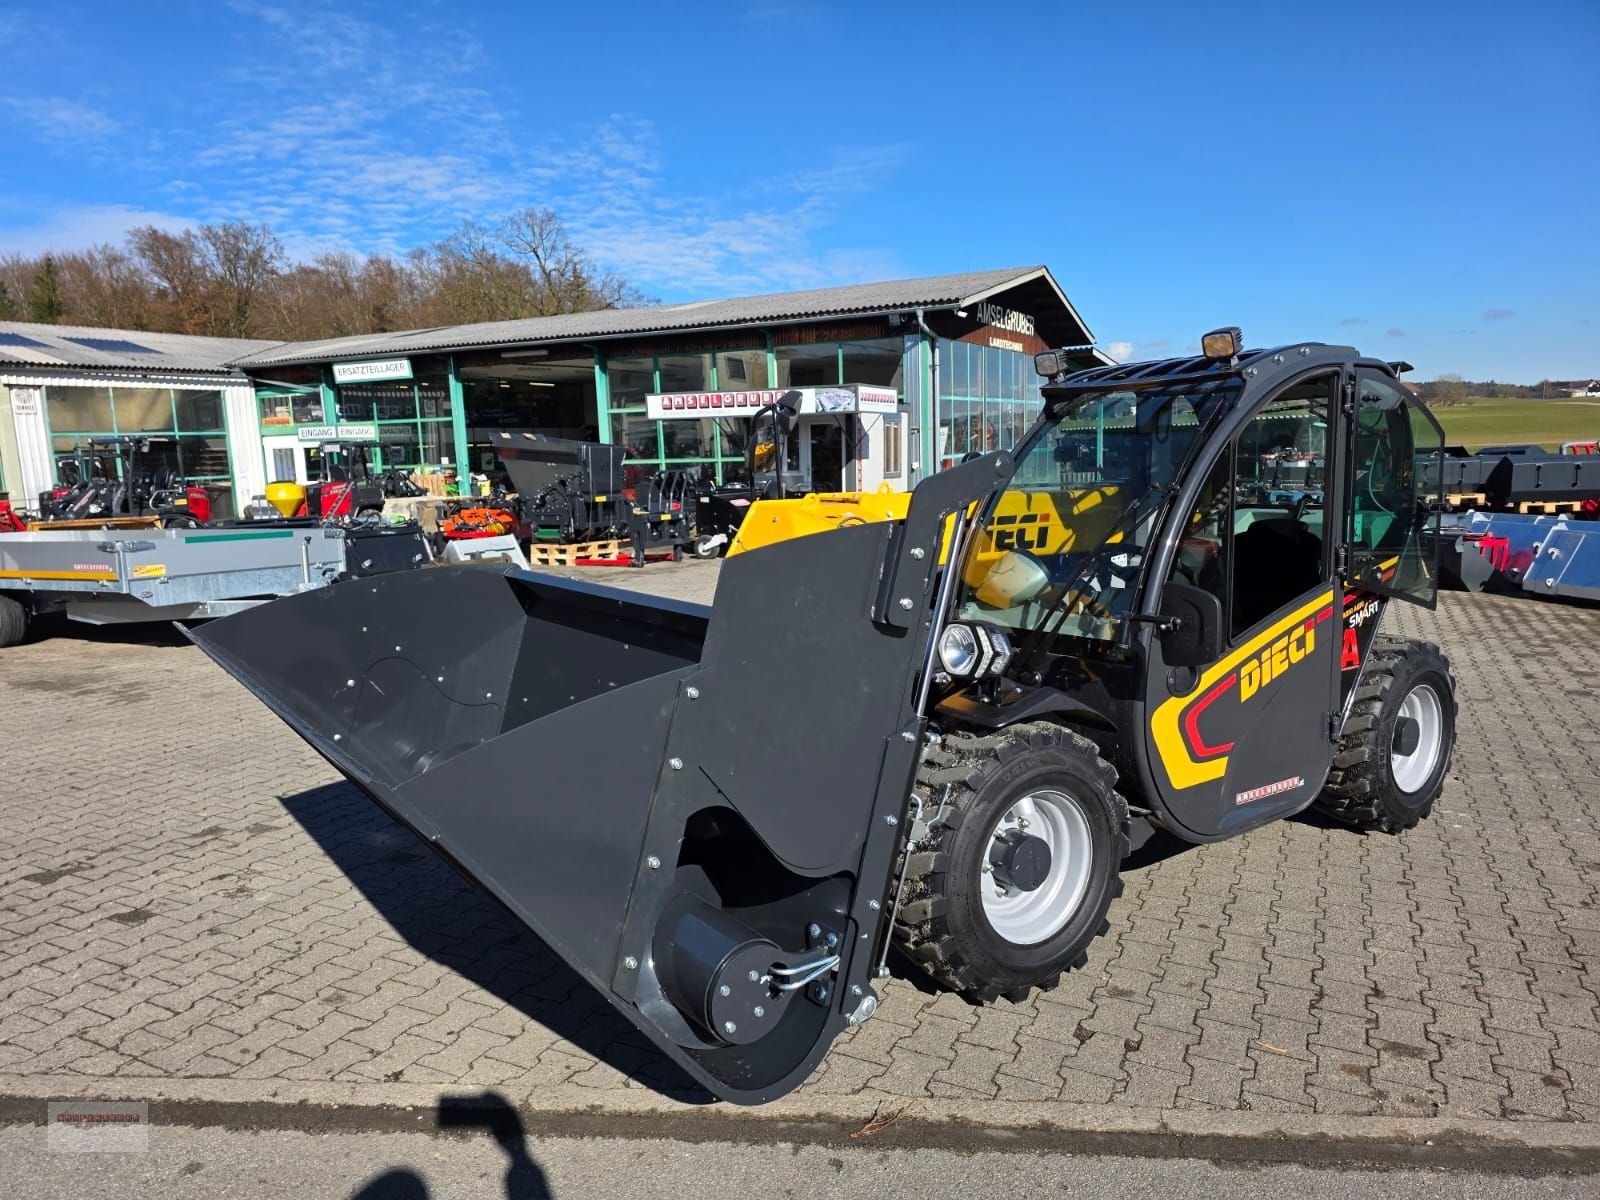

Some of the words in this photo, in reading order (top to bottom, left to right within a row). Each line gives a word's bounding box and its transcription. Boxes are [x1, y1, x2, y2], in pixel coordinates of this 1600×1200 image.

[976, 302, 1035, 337] AMSELGRUBER
[337, 362, 406, 377] ERSATZTEILLAGER
[300, 428, 333, 438] EINGANG
[340, 427, 373, 436] EINGANG
[1349, 600, 1379, 628] SMART
[1240, 618, 1315, 704] DIECI
